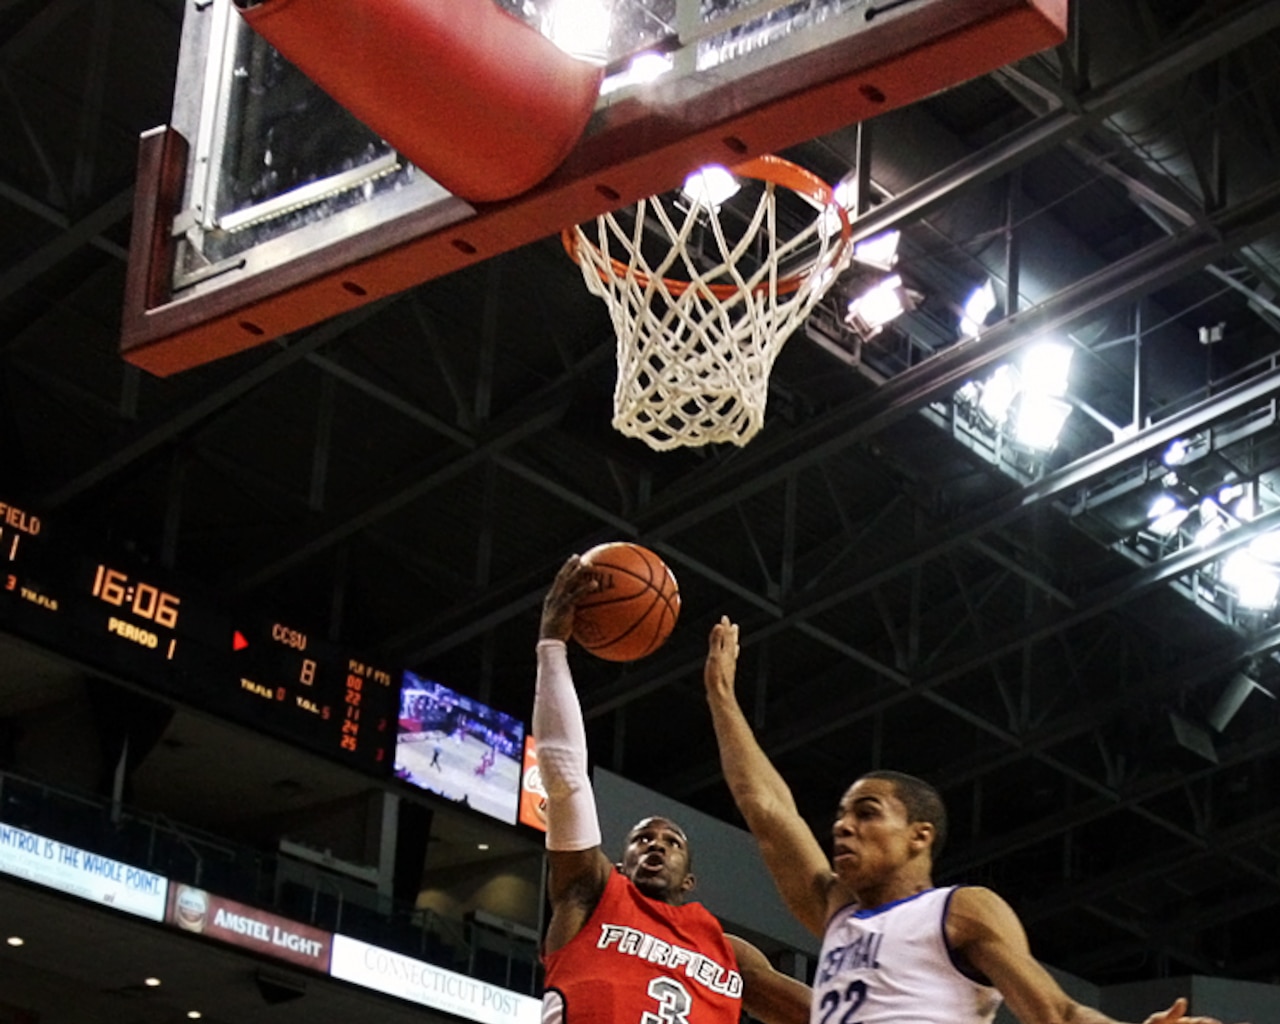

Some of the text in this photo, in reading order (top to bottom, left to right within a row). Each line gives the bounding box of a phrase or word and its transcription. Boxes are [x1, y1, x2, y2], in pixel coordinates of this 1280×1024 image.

[92, 564, 181, 629] 16:06
[108, 616, 177, 660] PERIOD 1
[272, 622, 307, 651] CCSU
[300, 658, 317, 687] 8
[44, 841, 55, 860] IS
[58, 844, 80, 869] THE
[82, 851, 123, 883] WHOLE
[213, 907, 324, 958] AMSTEL LIGHT
[363, 946, 479, 1003] CONNECTICUT
[480, 985, 522, 1018] POST
[597, 923, 743, 998] FAIRFIELD
